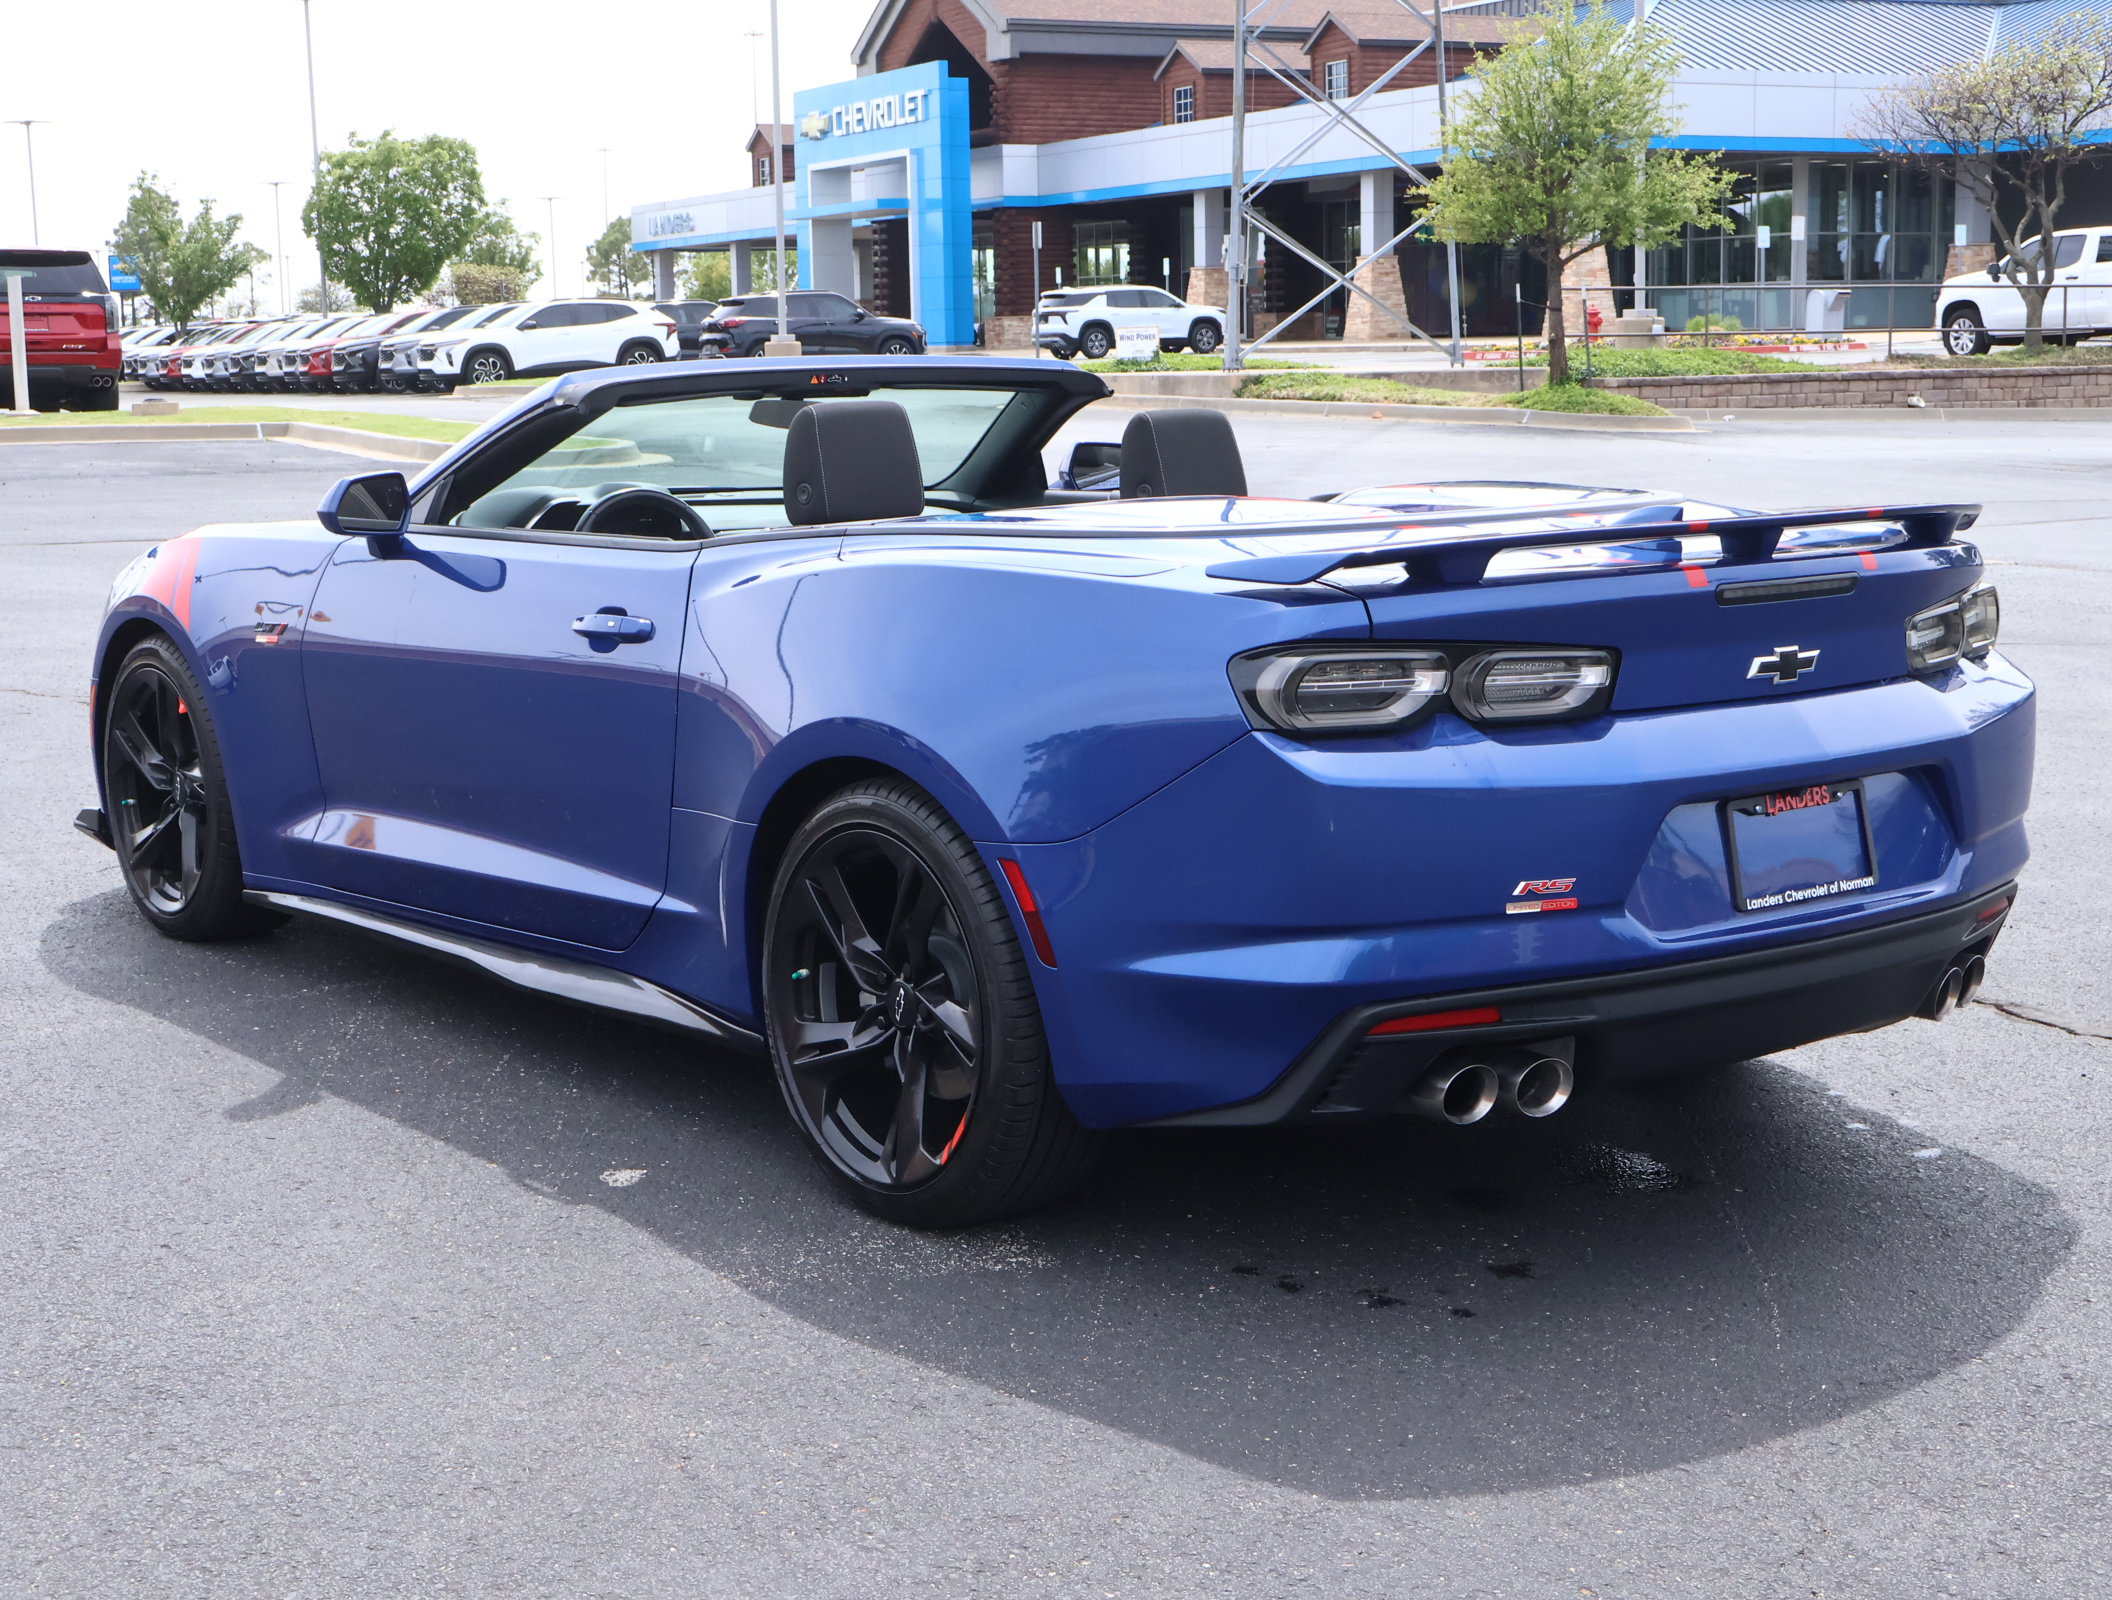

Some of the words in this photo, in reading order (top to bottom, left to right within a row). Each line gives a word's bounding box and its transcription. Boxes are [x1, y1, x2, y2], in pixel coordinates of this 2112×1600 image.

[832, 89, 928, 137] CHEVROLET
[1765, 784, 1830, 816] LANDERS
[1511, 877, 1577, 896] RS
[1746, 894, 1783, 910] Landers
[1784, 883, 1828, 903] Chevrolet
[1829, 881, 1839, 894] of
[1839, 876, 1875, 891] Norman
